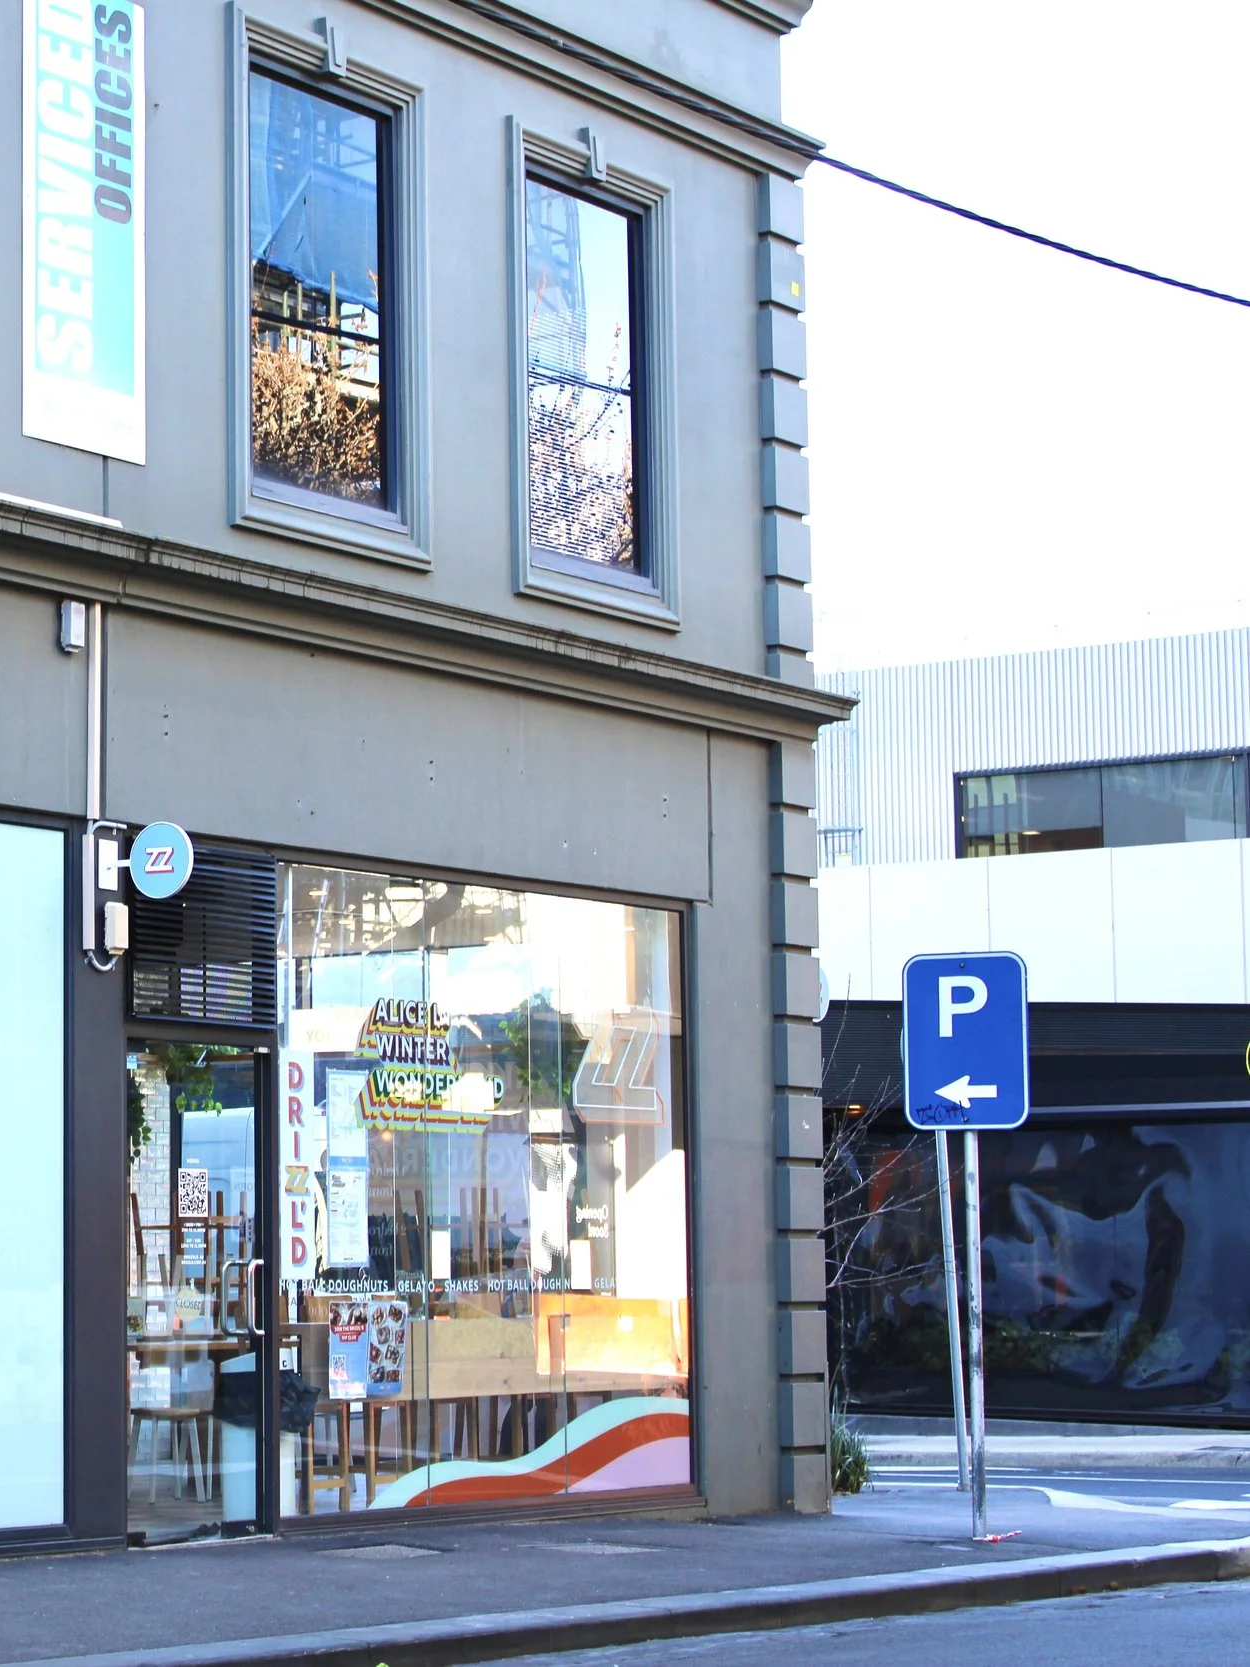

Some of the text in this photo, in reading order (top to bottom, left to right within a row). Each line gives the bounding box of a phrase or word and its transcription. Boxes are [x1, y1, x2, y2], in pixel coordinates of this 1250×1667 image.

[94, 4, 133, 225] OFFICES
[36, 0, 93, 373] SERVICED
[144, 846, 174, 874] ZZ
[375, 998, 428, 1026] ALICE
[938, 976, 988, 1038] P
[375, 1033, 448, 1060] WINTER
[375, 1069, 504, 1099] WONDERD
[328, 1279, 389, 1292] DOUGHNUTS
[397, 1280, 435, 1293] GELATO
[444, 1280, 479, 1293] SHAKES
[487, 1279, 505, 1292] HOT
[507, 1278, 529, 1291] BALL
[594, 1276, 615, 1290] GELA
[175, 1299, 203, 1311] CLOSED
